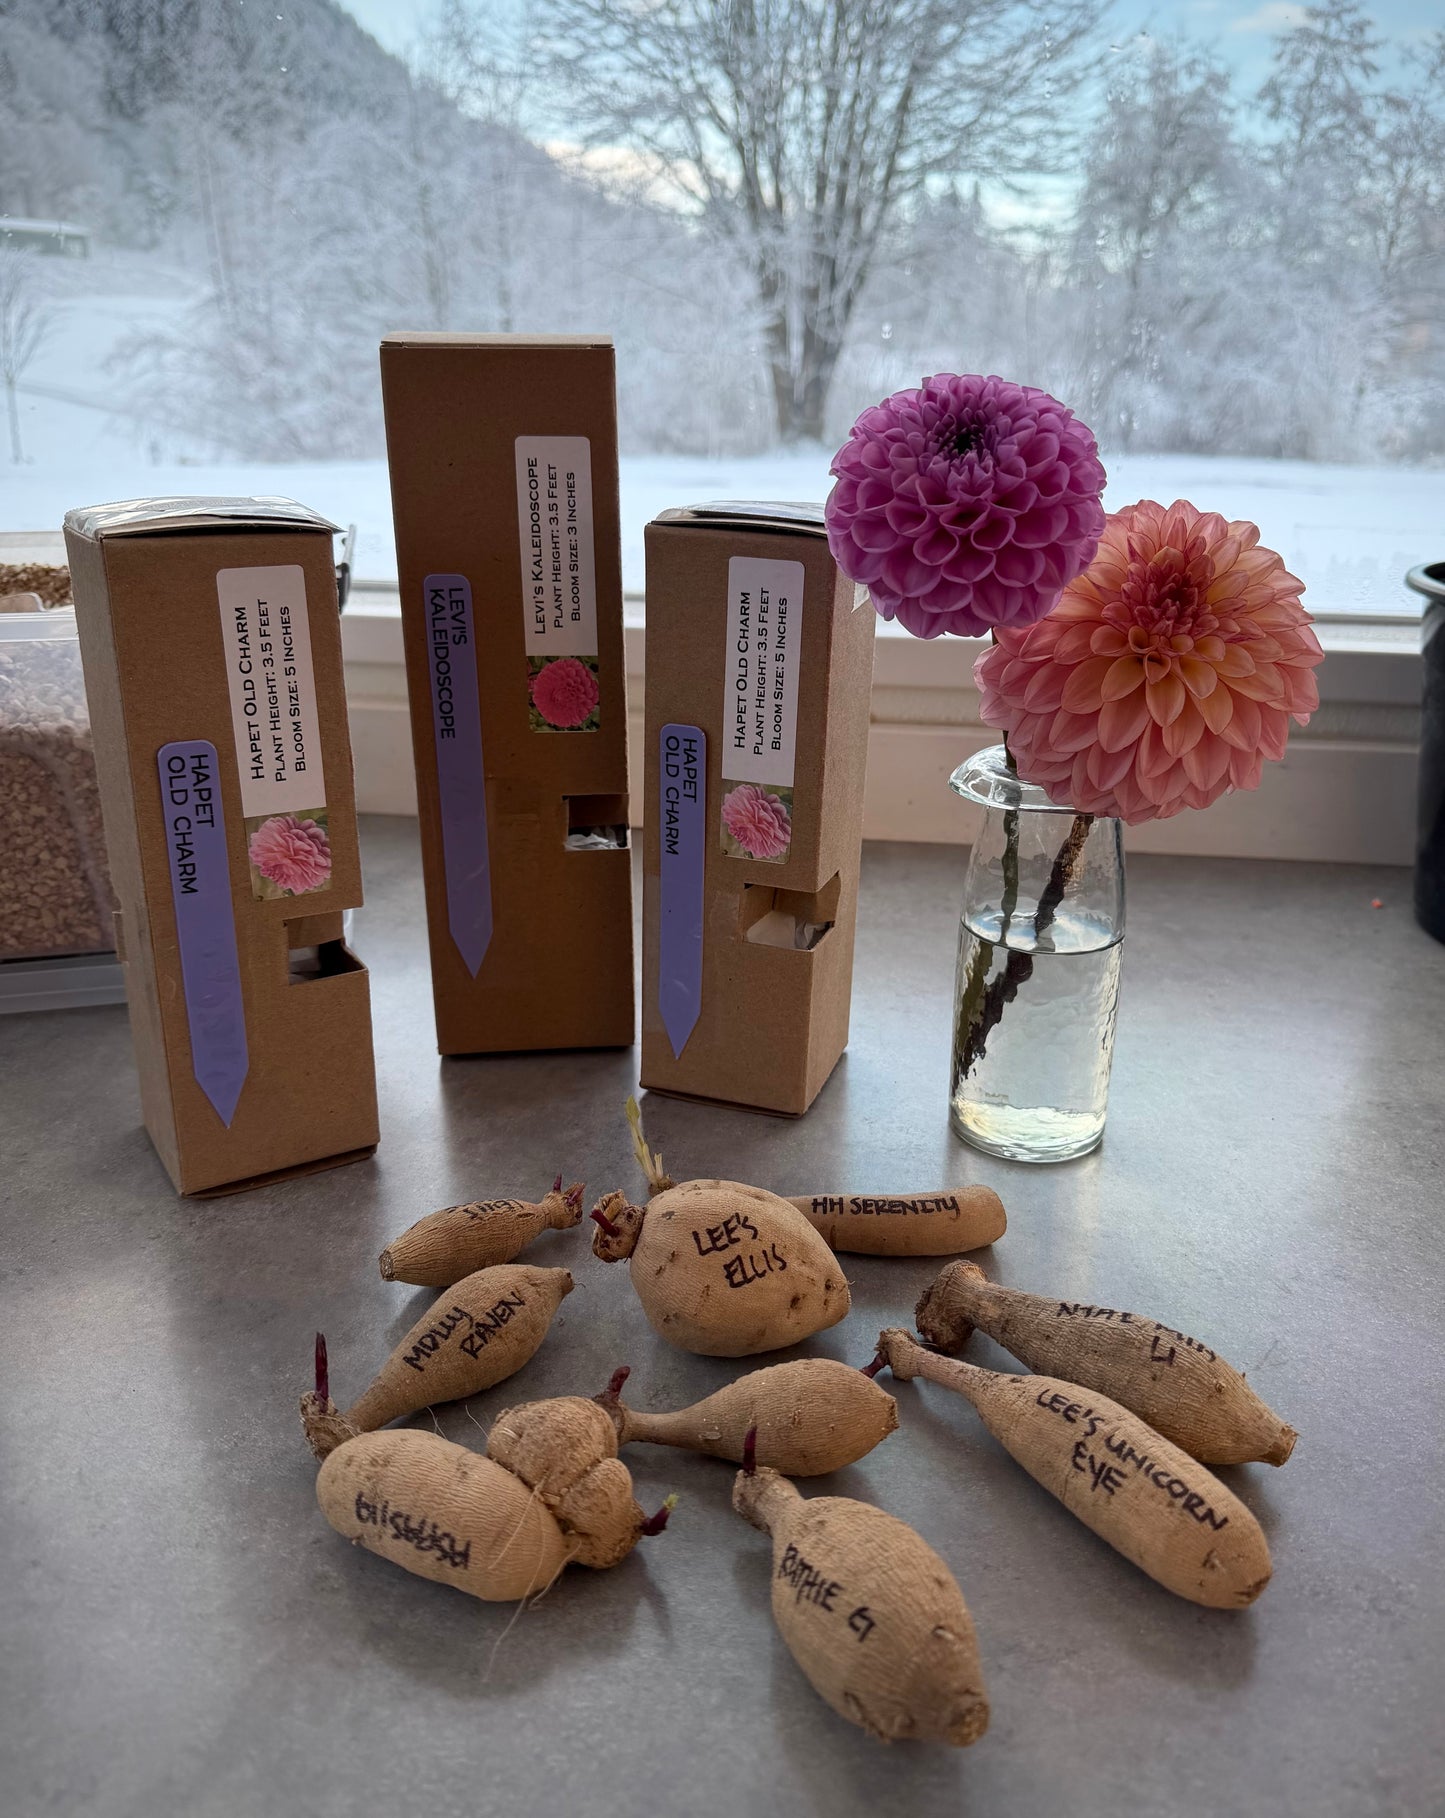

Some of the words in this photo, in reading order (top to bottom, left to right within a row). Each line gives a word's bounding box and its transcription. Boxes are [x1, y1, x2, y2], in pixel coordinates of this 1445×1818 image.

[548, 464, 558, 498] FEET
[566, 472, 576, 522] INCHES
[528, 458, 544, 581] KALEIDOSCOPE
[549, 502, 558, 526] 3.5
[568, 526, 577, 536] 3
[551, 529, 562, 582] HEIGHT:
[569, 539, 578, 572] SIZE:
[257, 599, 271, 638] FEET
[448, 588, 468, 646] LEVI'S
[533, 586, 546, 634] LEVI'S
[553, 586, 563, 628] PLANT
[570, 576, 580, 622] BLOOM
[737, 592, 750, 654] CHARM
[758, 587, 770, 624] FEET
[235, 606, 252, 675] CHARM
[280, 606, 294, 662] INCHES
[757, 628, 768, 651] 3.5
[776, 598, 788, 650] INCHES
[261, 642, 274, 668] 3.5
[285, 666, 296, 677] 5
[430, 588, 456, 739] KALEIDOSCOPE
[736, 657, 748, 692] OLD
[775, 652, 786, 663] 5
[244, 678, 258, 716] OLD
[266, 672, 281, 732] HEIGHT:
[288, 680, 301, 718] SIZE:
[755, 654, 767, 708] HEIGHT:
[774, 666, 784, 699] SIZE:
[292, 721, 306, 772] BLOOM
[734, 696, 747, 749] HAPET
[754, 712, 765, 756] PLANT
[771, 704, 782, 751] BLOOM
[248, 721, 265, 780] HAPET
[272, 734, 286, 782] PLANT
[666, 736, 679, 778] OLD
[683, 738, 698, 802] HAPET
[168, 756, 188, 806] OLD
[190, 754, 214, 828] HAPET
[666, 786, 679, 855] CHARM
[174, 816, 198, 894] CHARM
[811, 1197, 844, 1215] HH
[850, 1196, 960, 1220] SERENITY
[692, 1212, 758, 1256] LEE'S
[724, 1244, 787, 1288] ELLIS
[460, 1292, 526, 1360] RAVEN
[1036, 1388, 1104, 1436] LEE'S
[1105, 1434, 1229, 1531] UNICORN
[1071, 1440, 1128, 1496] EYE
